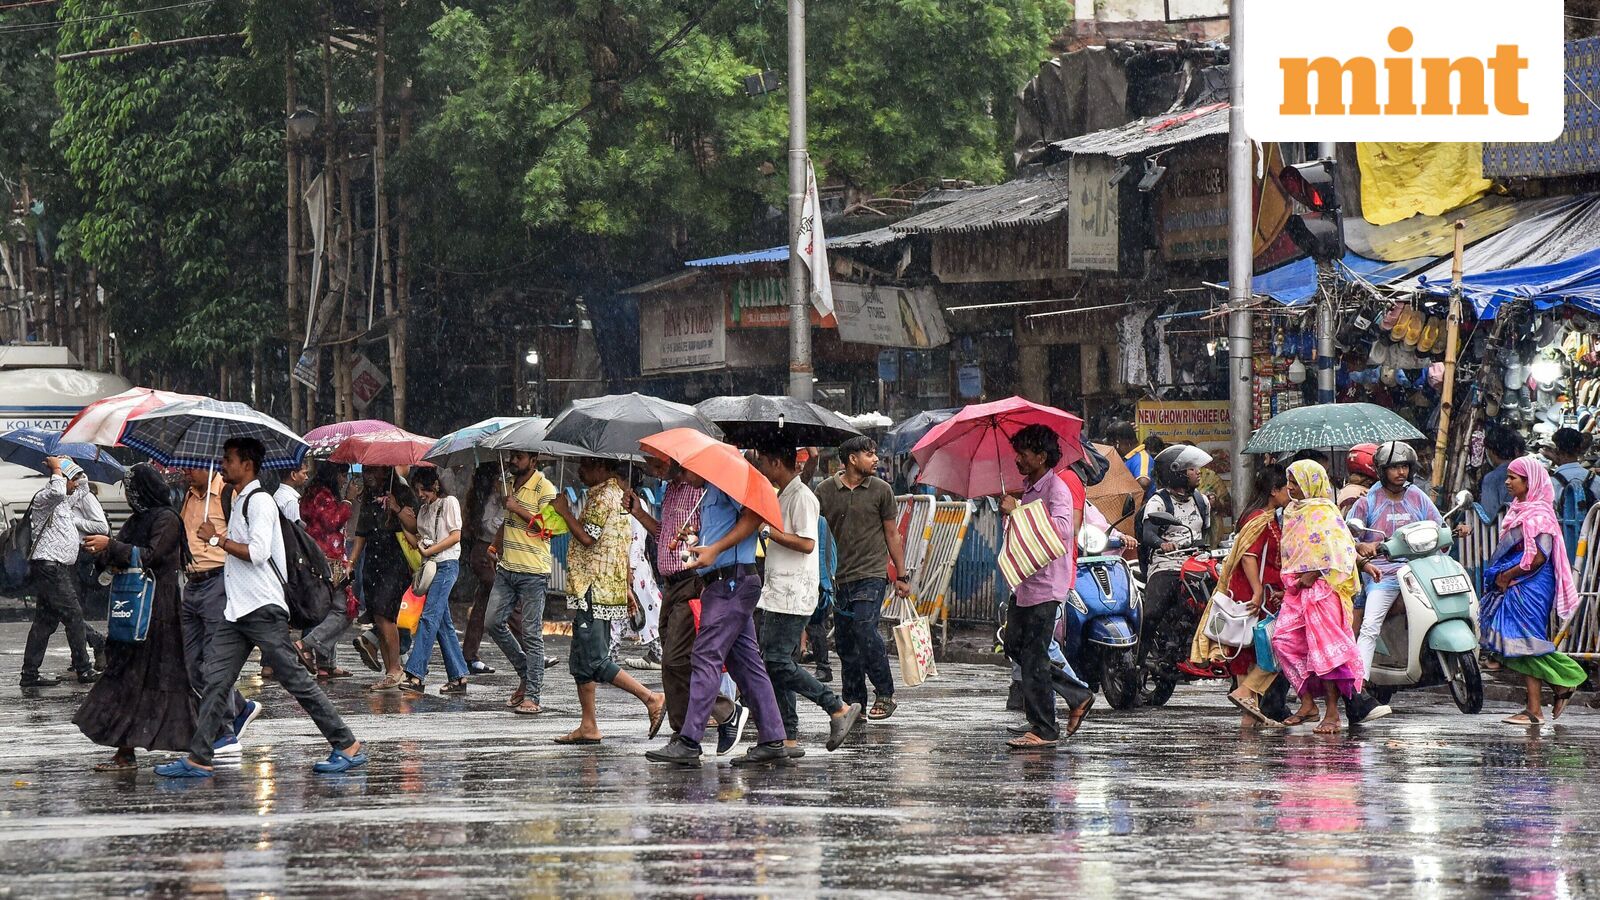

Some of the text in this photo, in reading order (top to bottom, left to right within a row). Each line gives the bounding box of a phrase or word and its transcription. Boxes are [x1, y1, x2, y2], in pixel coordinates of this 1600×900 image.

[1138, 409, 1156, 424] NEW
[1158, 408, 1218, 424] CHOWRINGHEE
[6, 420, 69, 430] KOLKATA
